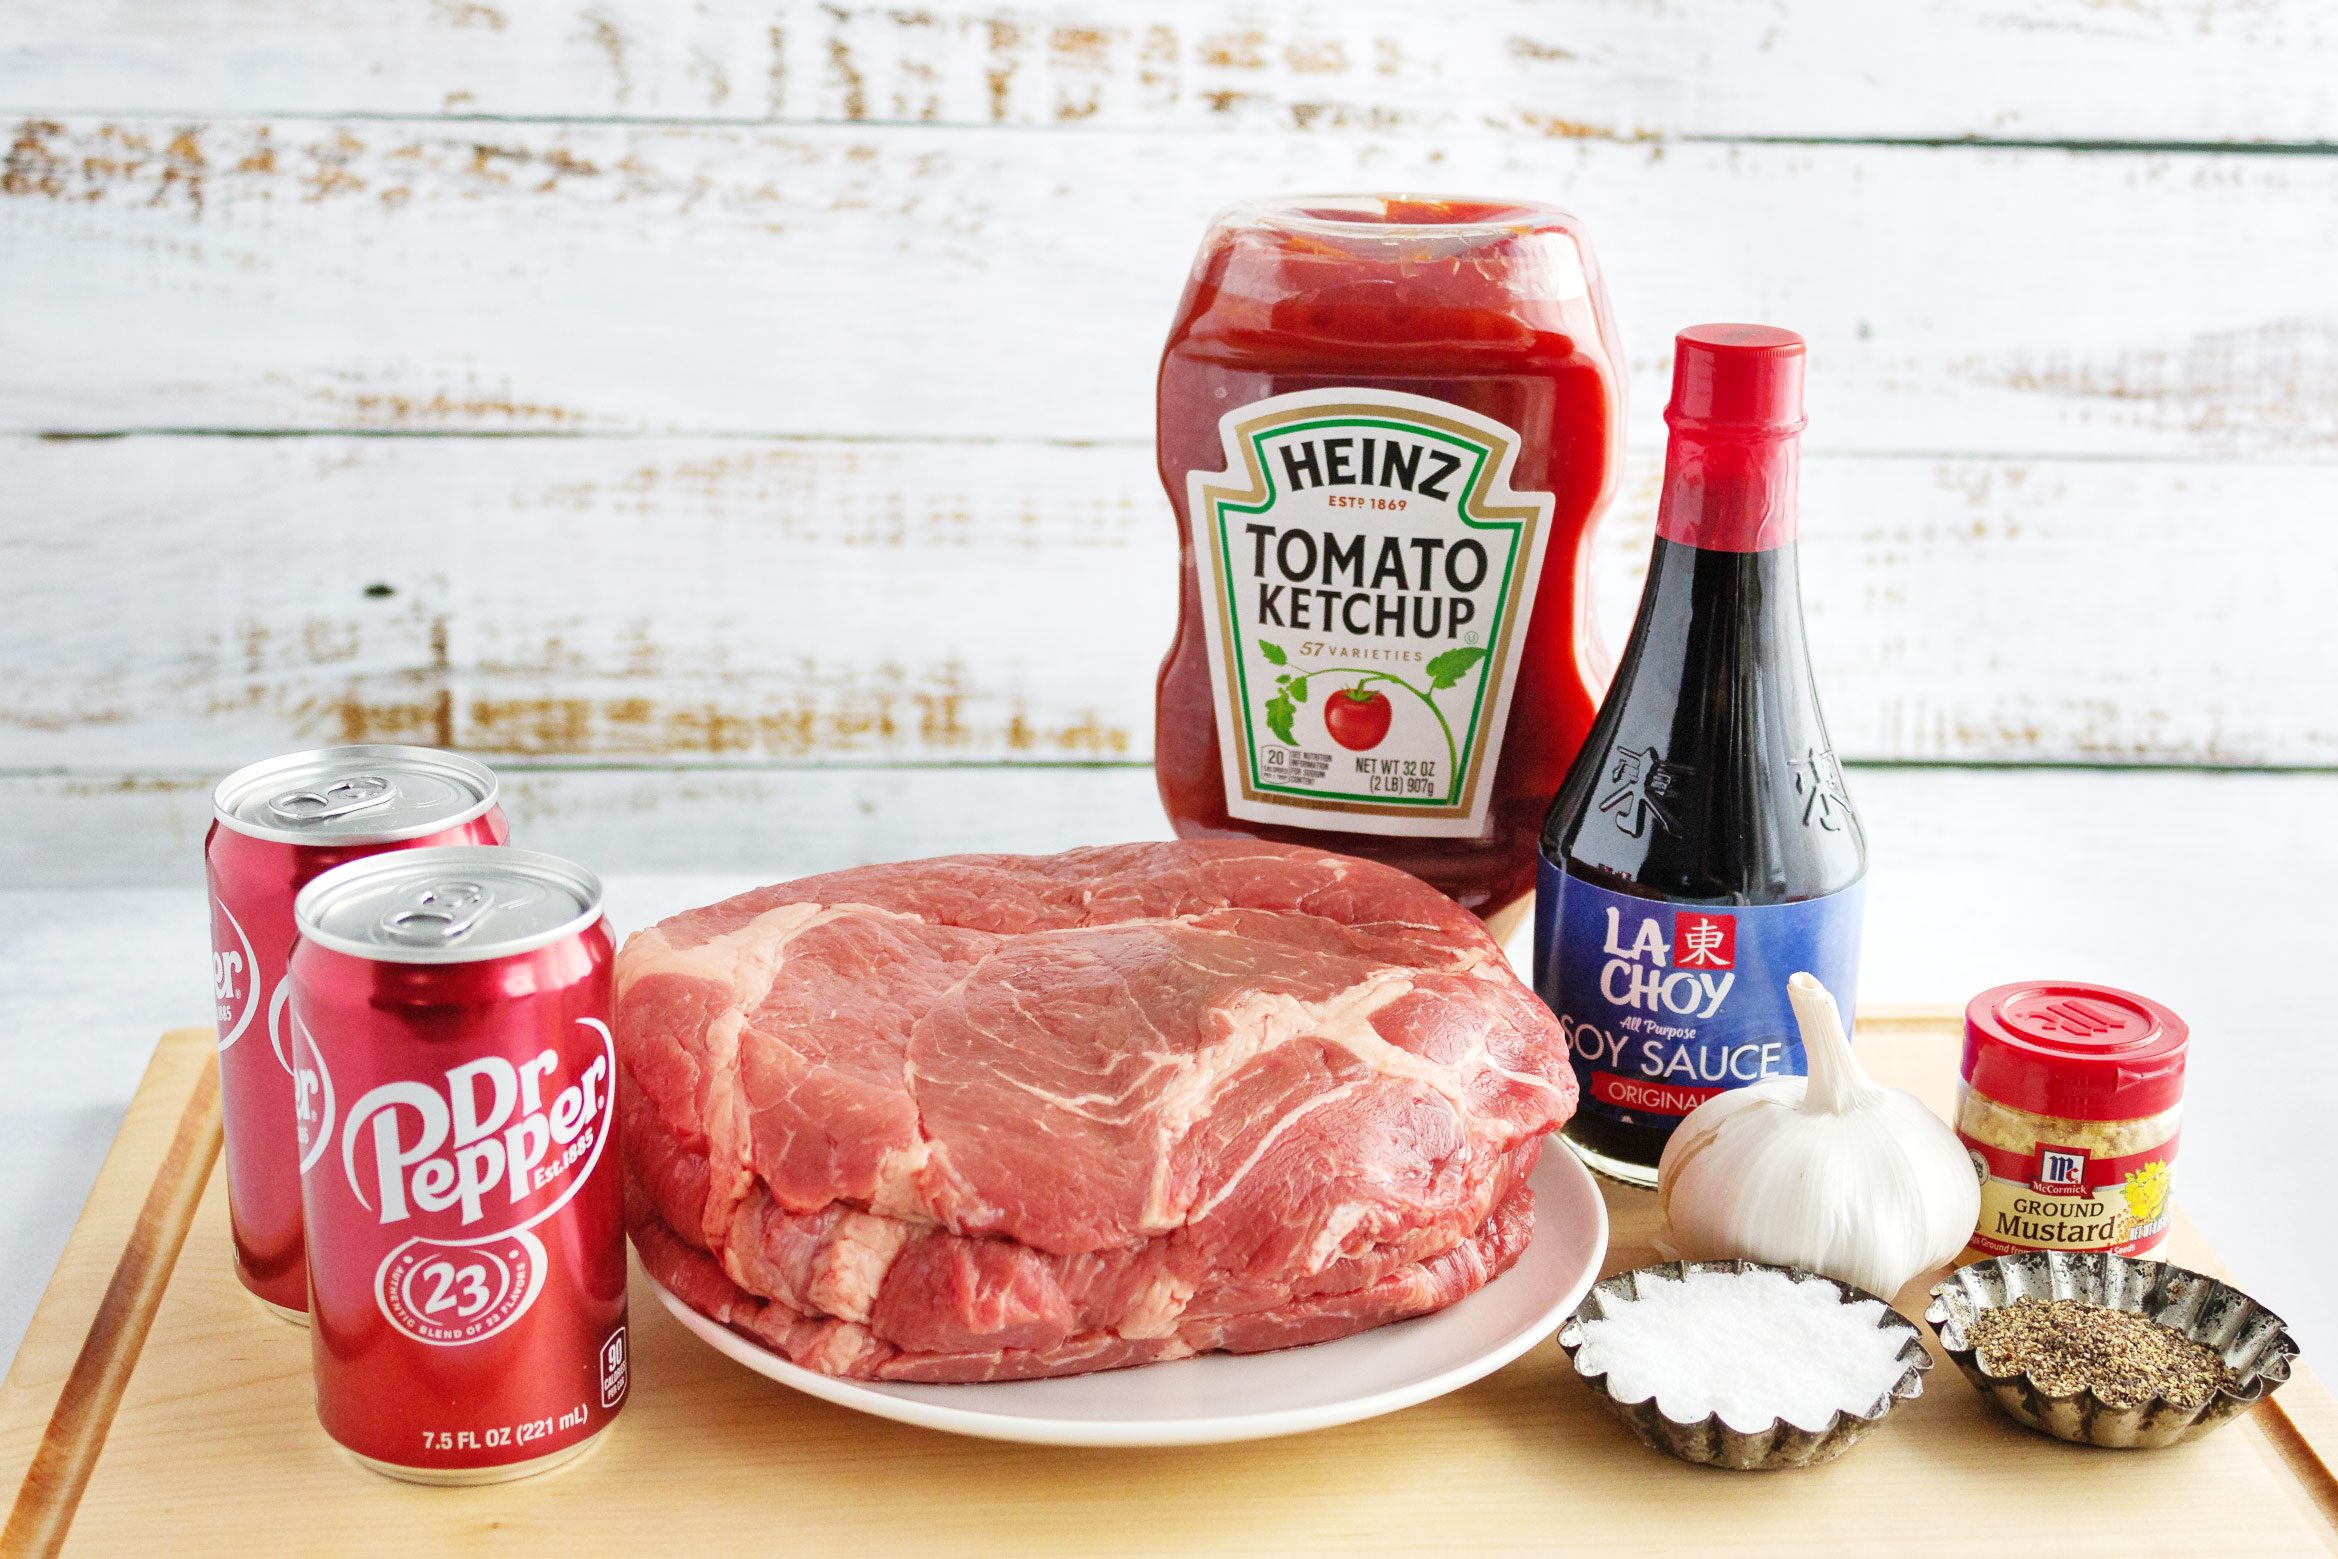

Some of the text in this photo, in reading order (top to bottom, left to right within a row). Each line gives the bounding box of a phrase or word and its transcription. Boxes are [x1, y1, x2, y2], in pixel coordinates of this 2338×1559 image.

[1279, 438, 1461, 502] HEINZ
[1370, 498, 1407, 511] 1869
[1245, 523, 1488, 593] TOMATO
[1258, 583, 1475, 639] KETCHUP
[1300, 641, 1423, 662] 57 VARIETIES
[1268, 749, 1284, 766] 20
[1355, 757, 1436, 777] NET WT 32 OZ
[1369, 776, 1434, 797] (2 LB) 907g
[1603, 906, 1670, 967] LA
[1679, 918, 1731, 966] 東
[1600, 959, 1735, 1019] CHOY
[1561, 1014, 1782, 1081] SOY SAUCE
[1620, 1016, 1697, 1041] All Purpose
[445, 1049, 558, 1149] Dr
[342, 1055, 606, 1226] Pepper
[2013, 1199, 2105, 1218] GROUND
[2033, 1181, 2088, 1194] McCormick
[1981, 1238, 2010, 1254] Ground
[2114, 1243, 2136, 1256] Seeds
[1994, 1211, 2116, 1243] Mustard
[390, 1261, 527, 1340] AUTHENTIC BLEND OF 23 FLAVORS
[423, 1262, 490, 1317] 23
[608, 1337, 622, 1373] 90
[422, 1402, 589, 1450] 7.5 FL OZ (221 mL)
